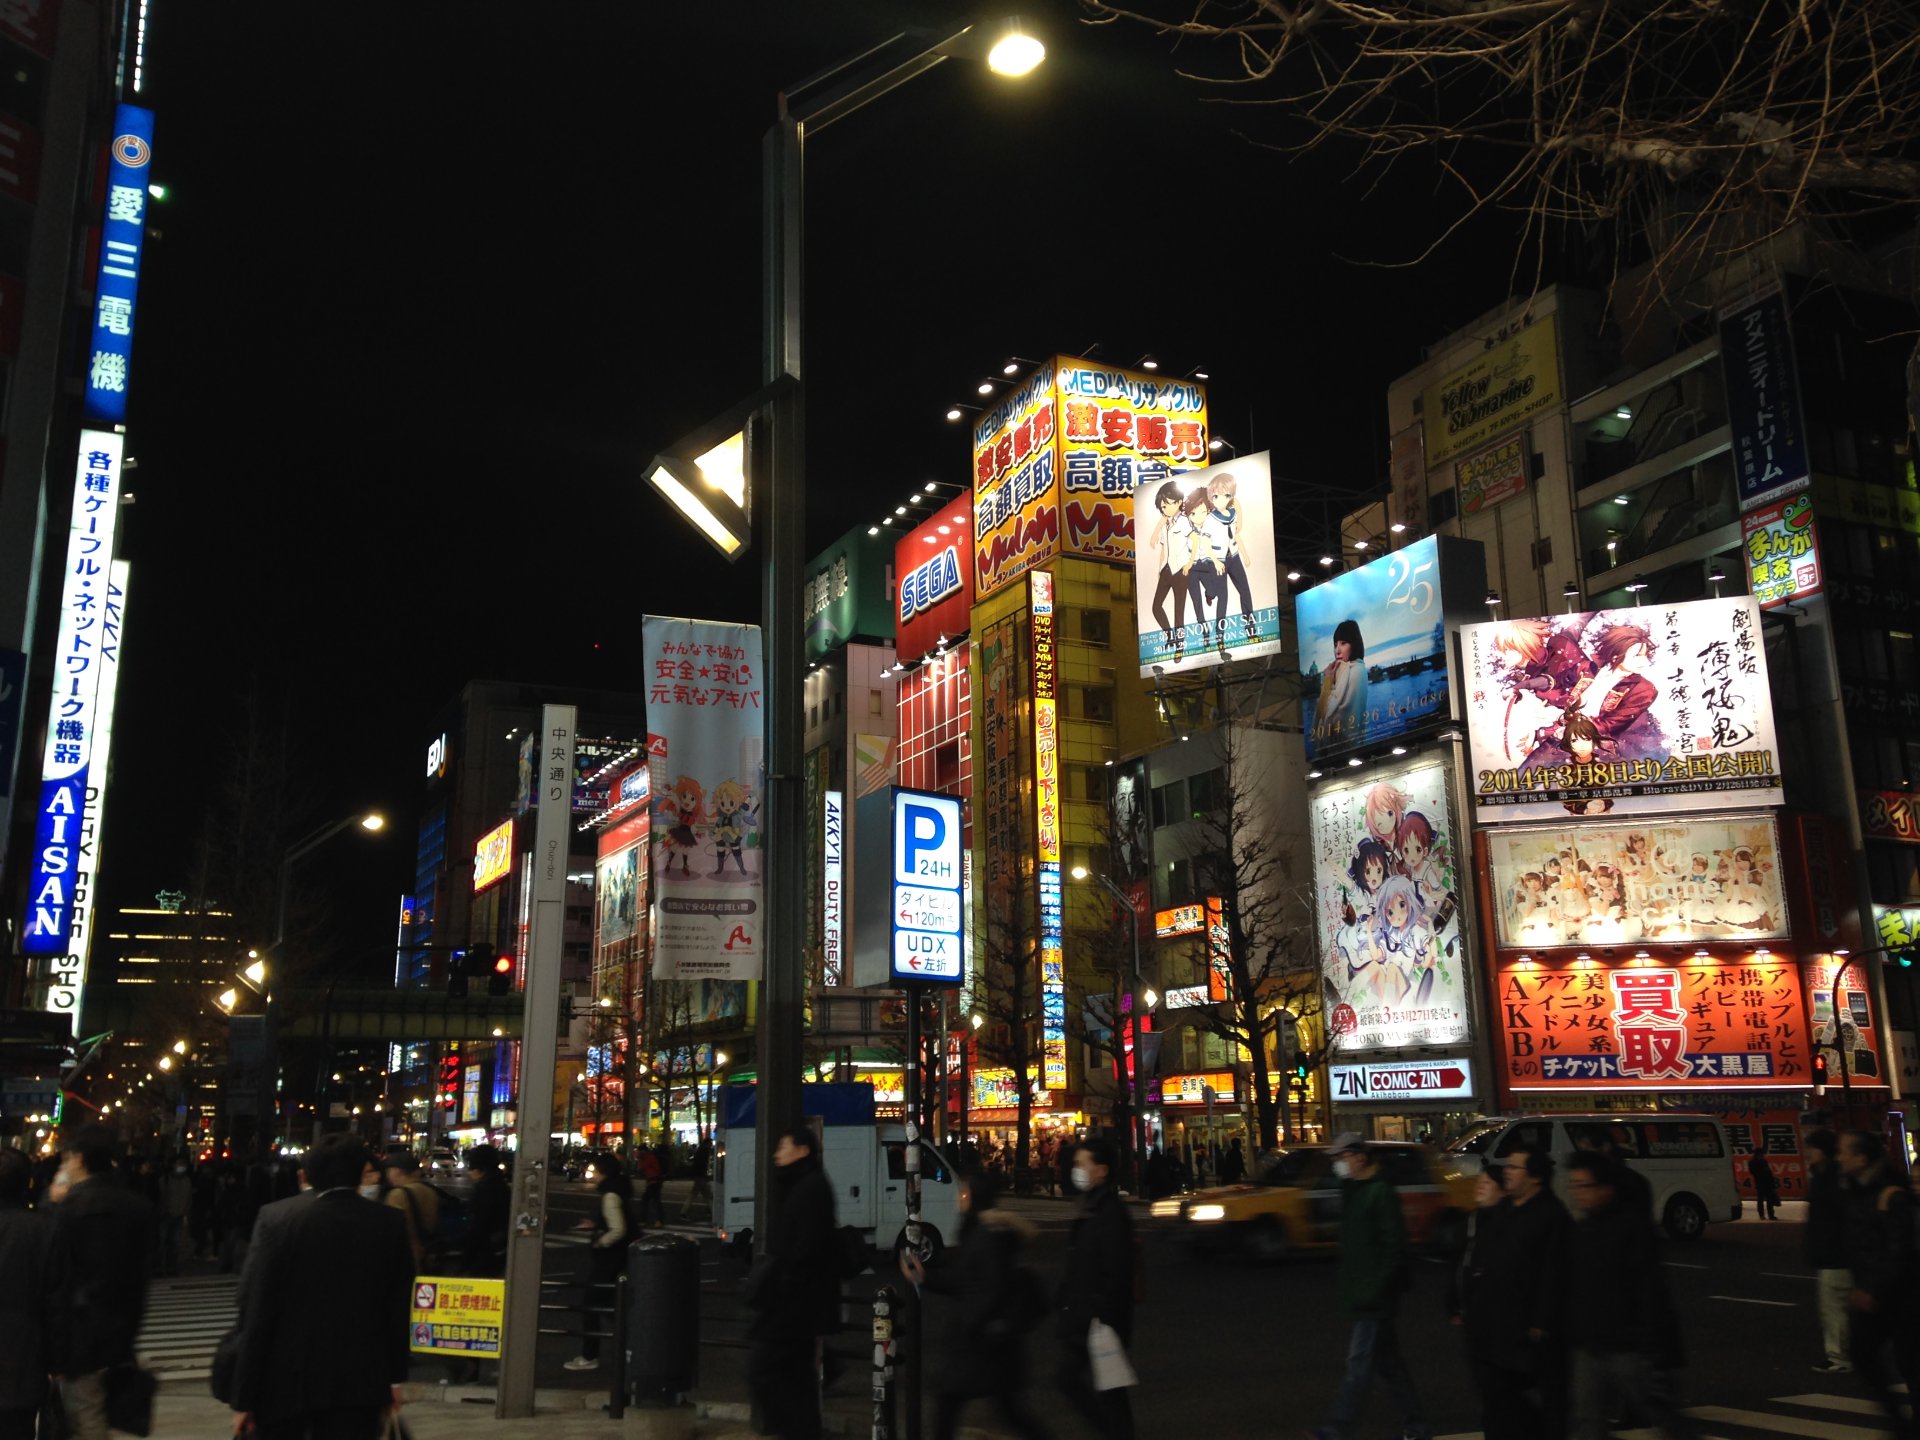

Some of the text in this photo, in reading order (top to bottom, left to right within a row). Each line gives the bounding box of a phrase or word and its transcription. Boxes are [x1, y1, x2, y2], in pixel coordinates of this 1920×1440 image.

[90, 185, 144, 392] 愛三電機
[1063, 369, 1203, 412] MEDIAリサイクル
[1441, 375, 1491, 417] Yellow
[1449, 374, 1535, 435] Submarine
[1743, 309, 1783, 482] アメニティードリーム
[977, 402, 1055, 491] 激安販売
[1066, 401, 1205, 458] 激安販売
[977, 450, 1053, 538] 高額買取
[977, 505, 1059, 590] Mulan
[1747, 529, 1813, 561] まんが
[902, 548, 962, 618] SEGA
[1387, 552, 1434, 614] 25
[1752, 557, 1790, 584] 喫茶
[54, 450, 112, 764] 各種ケーブル・ネットワーク機器
[1035, 616, 1051, 625] DVD
[1186, 620, 1217, 637] NOW
[1217, 615, 1238, 631] ON
[1240, 608, 1277, 626] SALE
[662, 641, 745, 661] みんなで協力
[1037, 644, 1049, 652] CD
[1223, 632, 1238, 641] ON
[1239, 625, 1264, 637] SALE
[1732, 608, 1759, 674] 劇場版
[1035, 662, 1052, 670] アニメ
[650, 684, 760, 708] 元気なアキバ
[1388, 689, 1446, 718] Release
[550, 727, 567, 800] 中央通り
[1036, 705, 1058, 856] お売り下さい!!
[1479, 750, 1775, 793] 2014年3月8日より全国公開!
[827, 800, 840, 853] AKKY
[904, 803, 946, 874] P
[1319, 807, 1333, 862] ですか?
[1331, 801, 1342, 848] うさぎ
[1341, 799, 1353, 857] ご注文は
[34, 786, 75, 936] AISAN
[920, 859, 951, 877] 24H
[828, 880, 838, 922] DUTY
[915, 911, 945, 926] 120m
[1175, 906, 1198, 923] 吉野家
[828, 929, 838, 969] FREE
[908, 934, 946, 954] UDX
[924, 957, 947, 972] 左折
[1336, 1008, 1351, 1022] TV
[1536, 975, 1561, 1051] アイドル
[1557, 974, 1582, 1030] アニメ
[1580, 973, 1612, 1052] 美少女系
[1688, 970, 1716, 1052] フィギュア
[1712, 970, 1736, 1028] ホビー
[1738, 968, 1771, 1051] 携帯電話
[1354, 1032, 1385, 1044] TOKYO
[1503, 976, 1538, 1076] AKB もの
[1612, 971, 1691, 1078] 買取
[1766, 968, 1801, 1078] アップルとか
[1047, 1064, 1065, 1072] AKIBA
[1334, 1066, 1368, 1098] ZIN
[1371, 1070, 1442, 1090] COMIC ZIN
[1543, 1055, 1770, 1078] チケット 大黒屋
[1371, 1091, 1410, 1099] Akihabara
[439, 1293, 501, 1311] 路上喫煙禁止
